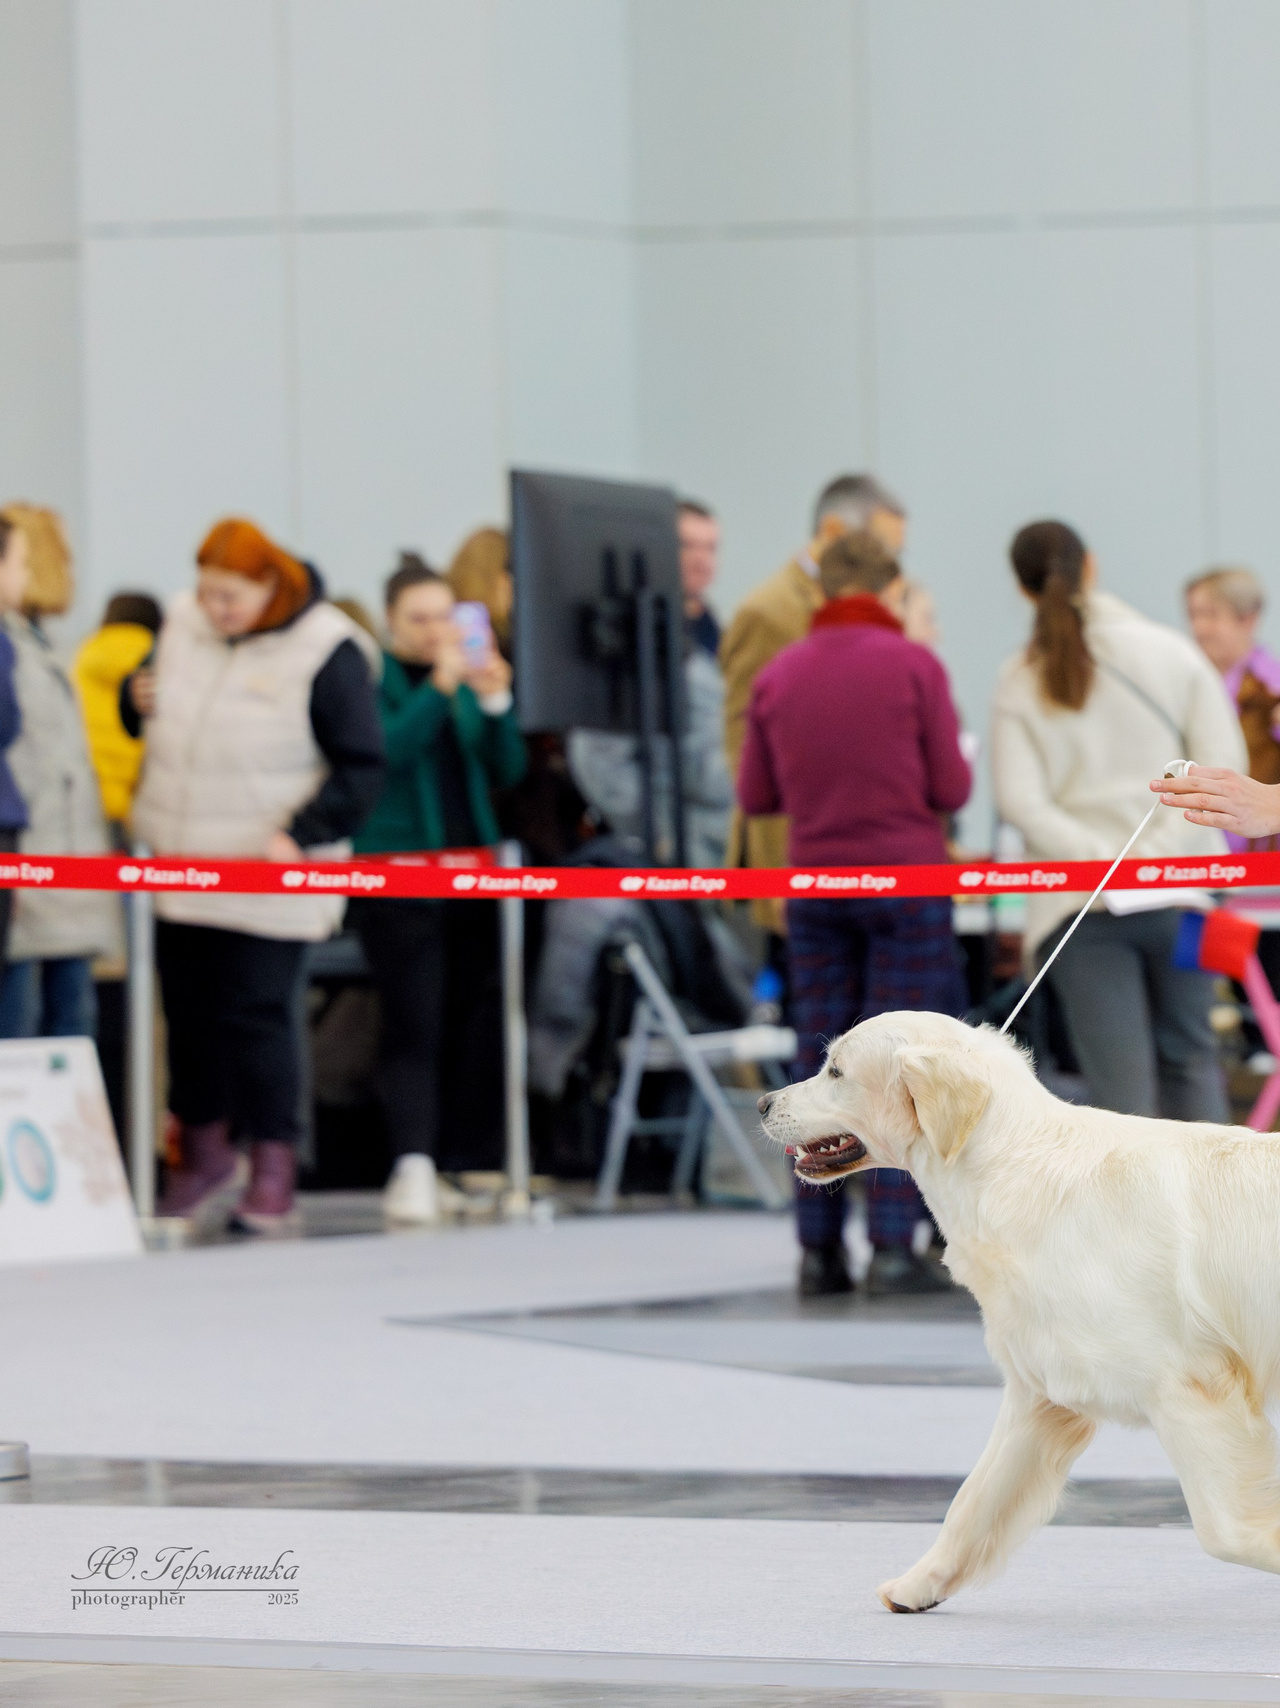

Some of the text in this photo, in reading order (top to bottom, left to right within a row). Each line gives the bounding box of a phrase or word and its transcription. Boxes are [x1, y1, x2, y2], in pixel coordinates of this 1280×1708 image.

[20, 863, 54, 882] Expo
[143, 867, 220, 887] Kazan Expo
[307, 871, 385, 890] Kazan Expo
[985, 870, 1067, 888] Kazan Expo
[1164, 864, 1246, 881] Kazan Expo
[478, 875, 557, 892] Kazan Expo
[645, 876, 726, 893] Kazan Expo
[815, 874, 896, 891] Kazan Expo
